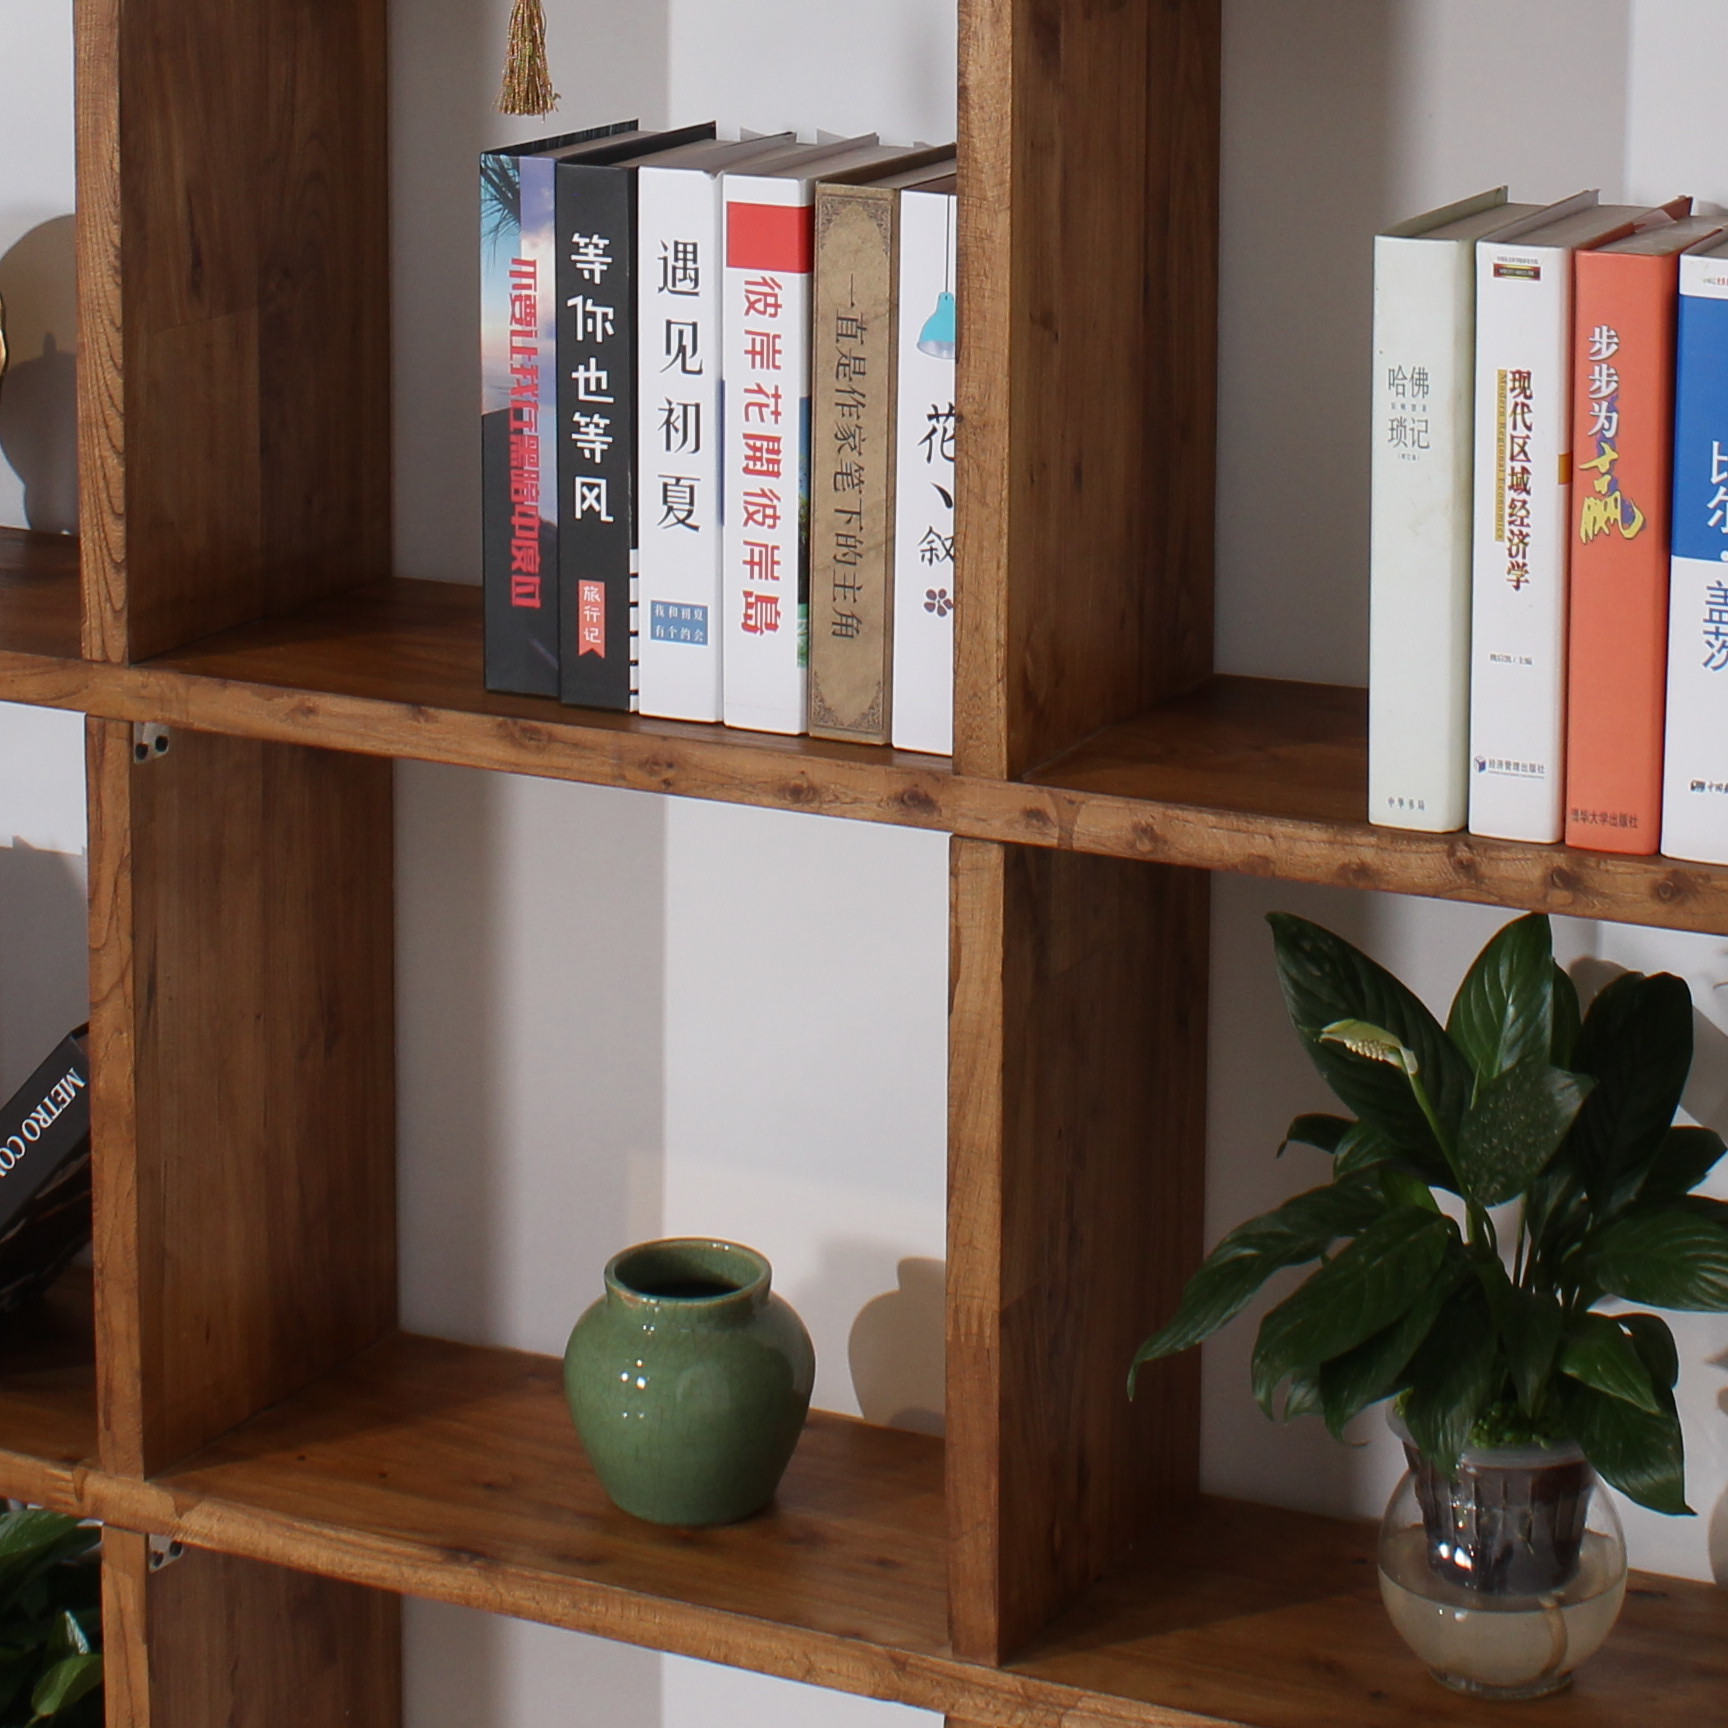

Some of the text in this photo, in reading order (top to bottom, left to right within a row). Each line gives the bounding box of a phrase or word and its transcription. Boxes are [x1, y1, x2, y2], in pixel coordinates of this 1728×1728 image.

[567, 232, 616, 525] 等你也等风
[656, 239, 704, 533] 遇见初夏
[1388, 364, 1430, 400] 哈佛
[508, 257, 542, 609] 不要让我在黑暗中度过
[741, 275, 784, 638] 彼岸花開彼岸島
[831, 273, 868, 639] 一直是作家笔下的主角
[1388, 416, 1430, 450] 琐记
[1580, 324, 1646, 546] 步步为赢
[1505, 368, 1534, 592] 现代区域经济学
[583, 585, 602, 644] 旅行记
[654, 605, 706, 621] 我和初夏
[654, 624, 705, 642] 有个约会
[1488, 759, 1545, 774] 经济管理出版社
[1571, 808, 1638, 829] 清华大学出版社
[8, 1066, 87, 1144] METRO
